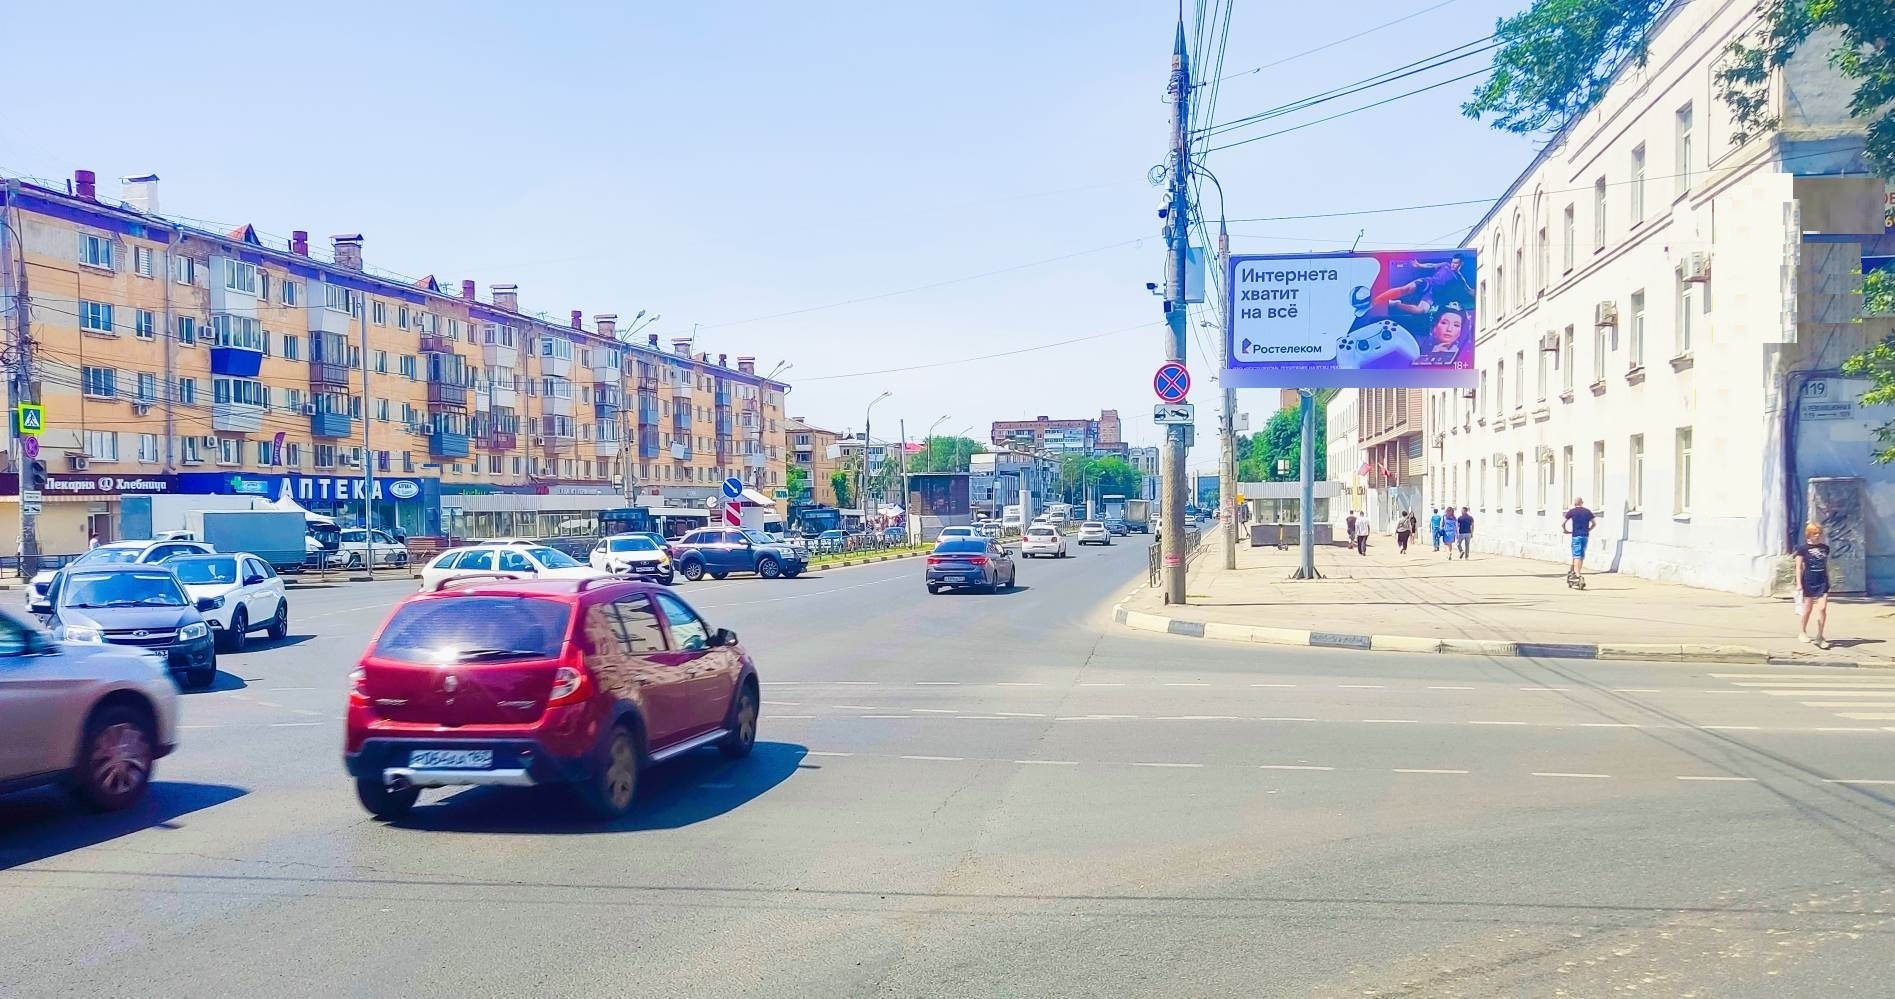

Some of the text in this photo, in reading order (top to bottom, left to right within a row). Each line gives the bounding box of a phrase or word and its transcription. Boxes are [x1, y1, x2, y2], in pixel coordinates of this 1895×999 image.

[1241, 268, 1338, 285] Интернета
[1241, 289, 1299, 301] хватит
[1241, 303, 1298, 319] на всё
[1252, 344, 1322, 354] Ростелеком
[1453, 361, 1469, 370] 18+
[1801, 382, 1825, 395] 119
[45, 478, 167, 492] Пекарня Хлебница
[278, 478, 383, 500] АПТЕКА
